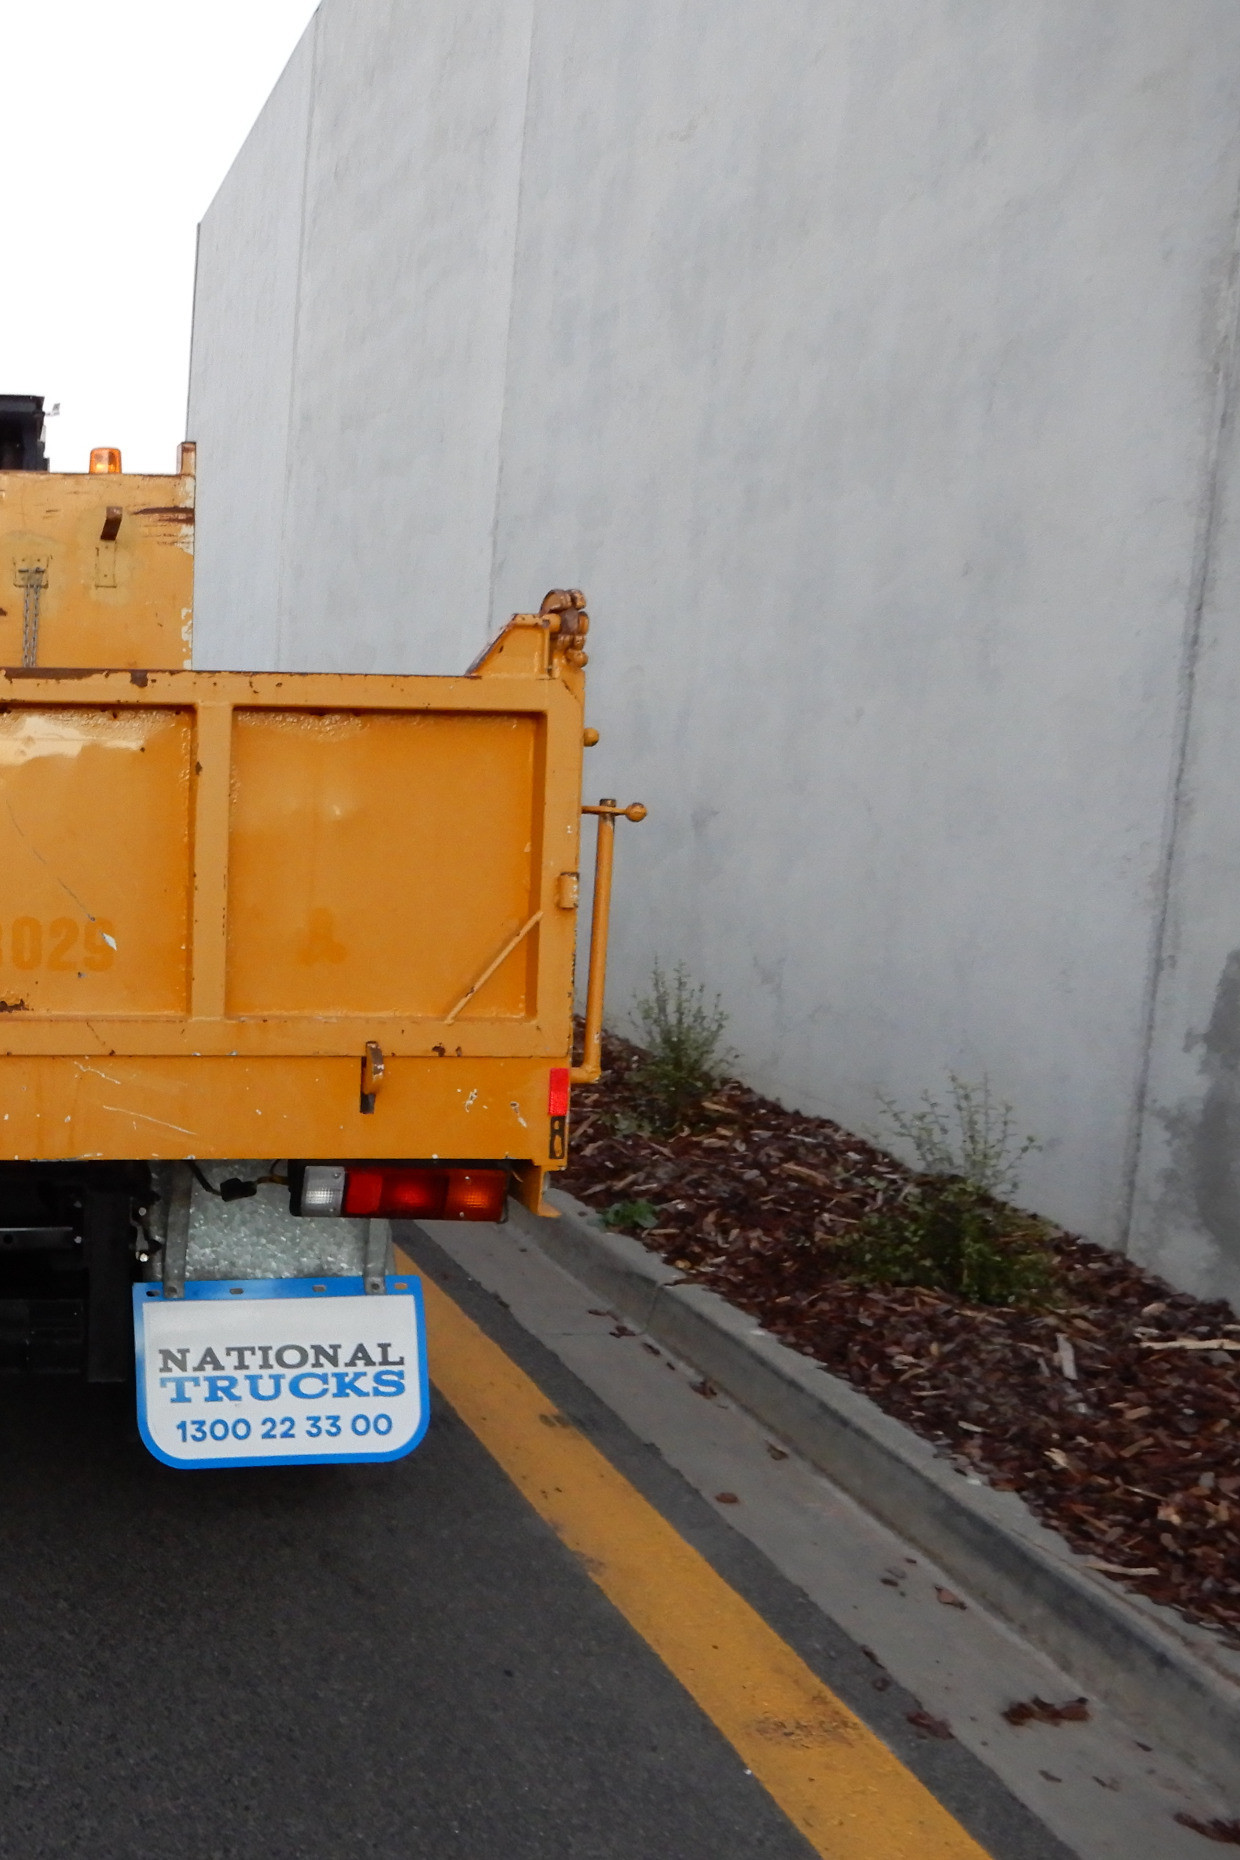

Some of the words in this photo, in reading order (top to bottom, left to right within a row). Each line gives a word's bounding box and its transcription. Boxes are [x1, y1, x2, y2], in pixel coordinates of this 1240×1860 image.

[158, 1342, 405, 1373] NATIONAL
[159, 1369, 406, 1403] TRUCKS
[176, 1417, 253, 1443] 1300
[260, 1415, 296, 1440] 22
[305, 1414, 342, 1438] 33
[350, 1412, 394, 1437] 00
